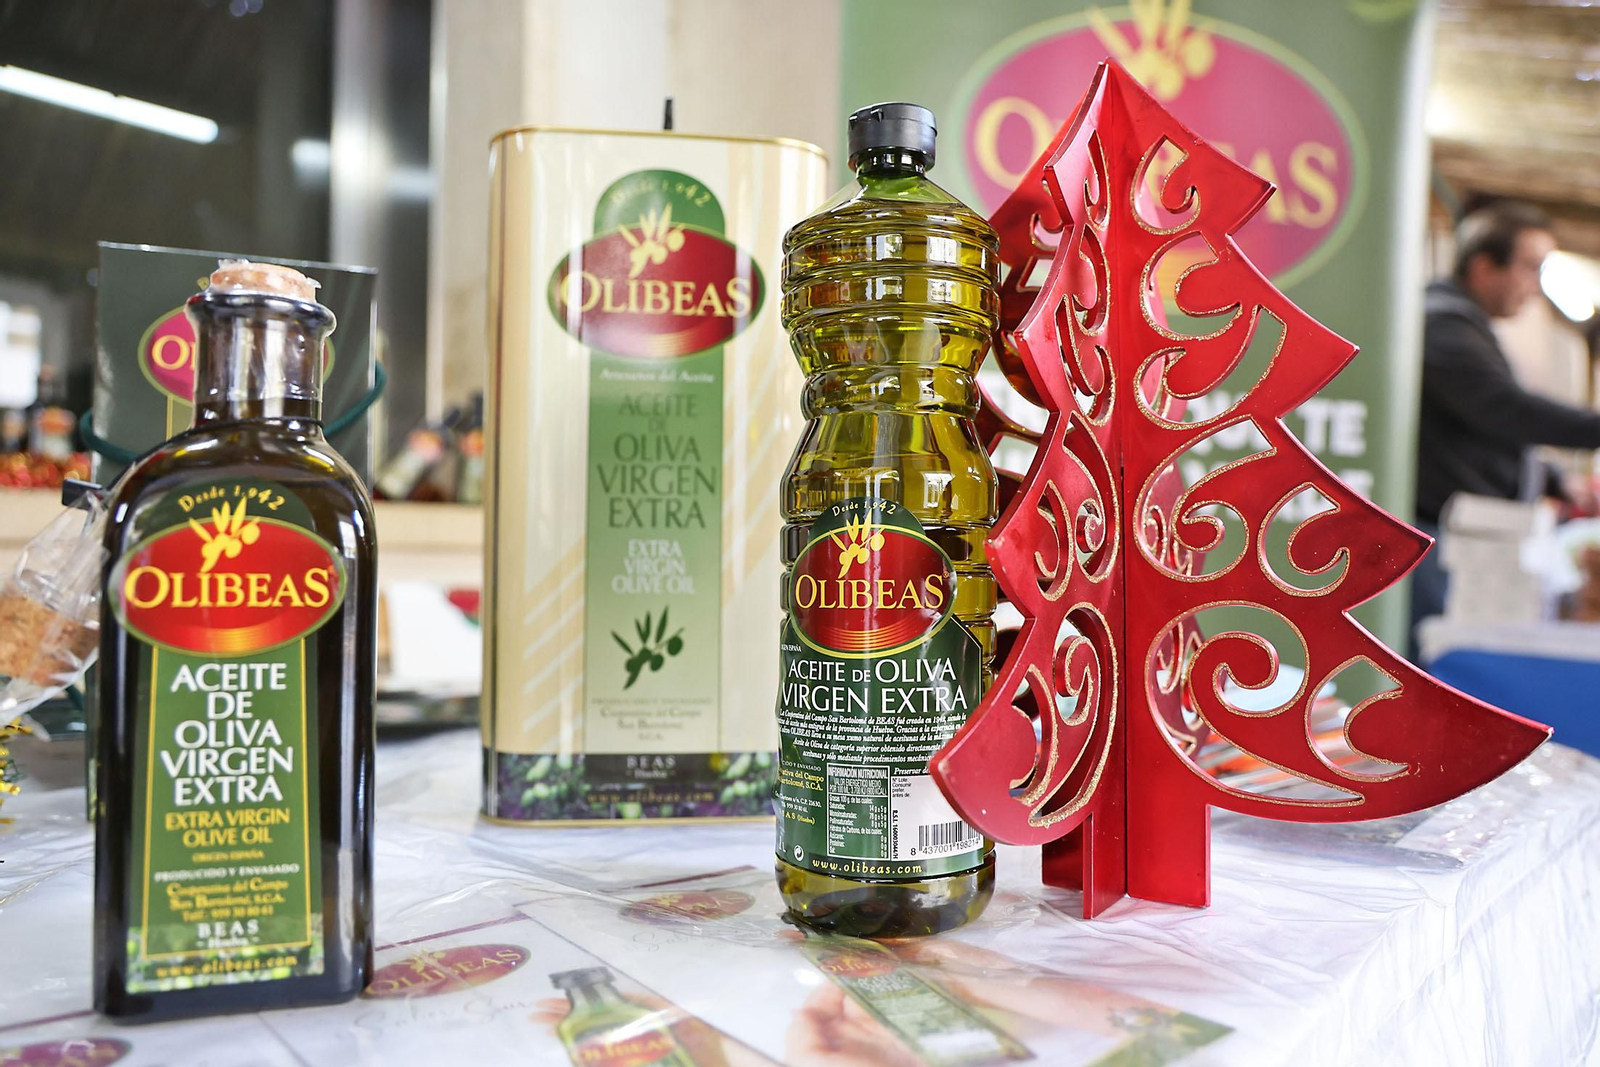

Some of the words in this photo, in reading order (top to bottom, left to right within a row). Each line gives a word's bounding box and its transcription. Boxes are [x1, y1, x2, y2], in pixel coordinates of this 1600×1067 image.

[560, 271, 751, 318] OLIBEAS
[618, 393, 698, 418] ACEITE
[1295, 398, 1367, 458] TE
[614, 433, 701, 462] OLIVA
[597, 464, 716, 496] VIRGEN
[178, 485, 226, 512] Desde
[832, 501, 859, 517] Desde
[608, 498, 706, 529] EXTRA
[627, 539, 683, 558] EXTRA
[124, 566, 329, 609] OLIBEAS
[611, 575, 664, 594] OLIVE
[665, 575, 695, 595] OIL
[795, 573, 944, 610] OLIBEAS
[171, 663, 287, 692] ACEITE
[788, 659, 845, 682] ACEITE
[852, 669, 871, 683] DE
[875, 657, 957, 683] OLIVA
[207, 691, 253, 719] DE
[781, 682, 869, 713] VIRGEN
[881, 685, 968, 714] EXTRA
[174, 719, 282, 749] OLIVA
[838, 724, 864, 734] provincia
[865, 724, 872, 733] de
[863, 733, 884, 742] natural
[160, 746, 294, 778] VIRGEN
[627, 755, 676, 770] BEAS
[893, 767, 921, 775] Preservar
[174, 775, 283, 806] EXTRA
[165, 811, 224, 831] EXTRA
[225, 808, 291, 826] VIRGIN
[183, 828, 238, 847] OLIVE
[241, 827, 273, 844] OIL
[910, 847, 917, 856] 8
[812, 859, 922, 875] www.olibeas.com
[197, 919, 260, 938] BEAS
